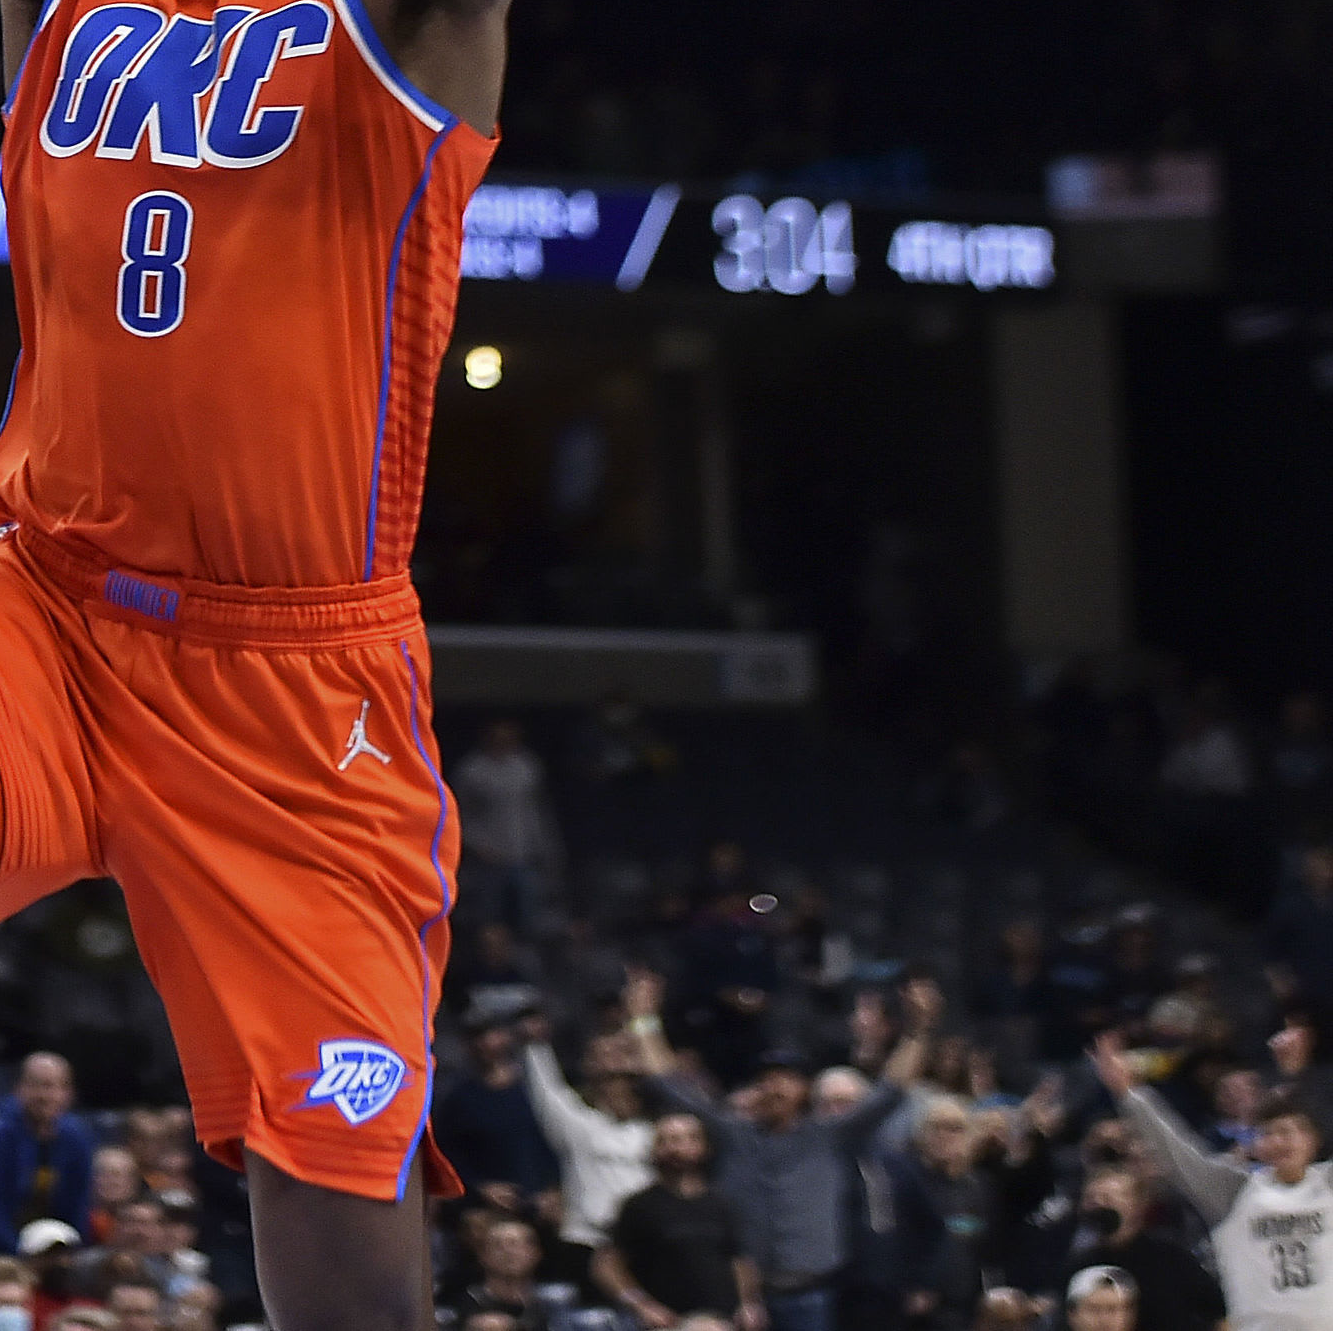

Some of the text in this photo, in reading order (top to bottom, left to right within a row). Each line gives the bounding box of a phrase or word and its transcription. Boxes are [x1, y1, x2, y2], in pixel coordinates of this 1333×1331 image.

[38, 0, 336, 169] OKC
[116, 189, 194, 338] 8
[104, 568, 180, 623] THUNDER
